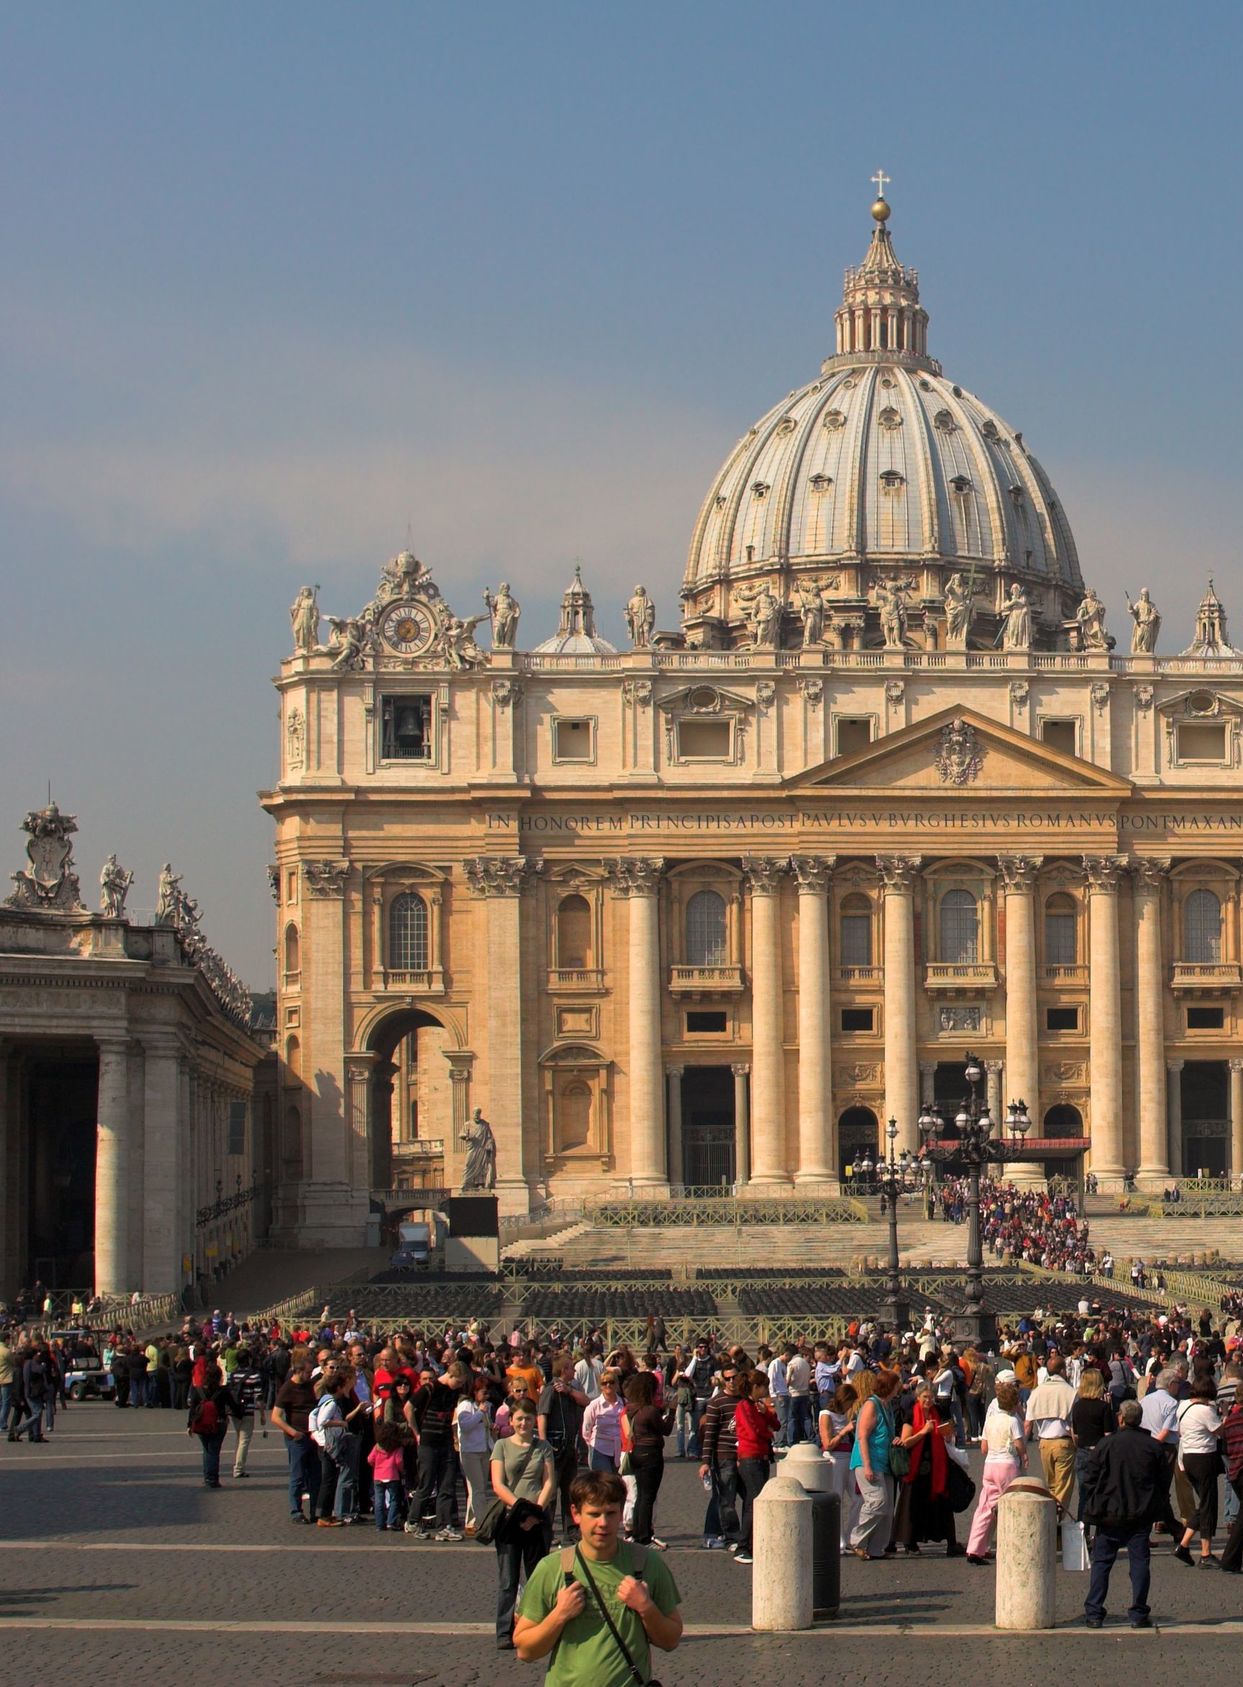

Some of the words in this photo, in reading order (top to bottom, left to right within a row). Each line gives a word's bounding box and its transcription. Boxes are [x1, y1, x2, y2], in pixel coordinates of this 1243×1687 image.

[487, 814, 511, 829] IN
[520, 815, 624, 831] HONOREM
[629, 813, 731, 830] PRINCIPIS
[735, 813, 797, 829] APOST
[801, 812, 867, 828] PAVLVS
[888, 813, 1011, 829] BVRGHESIVS
[1016, 813, 1117, 828] ROMANVS
[1120, 815, 1169, 830] PONT
[1172, 816, 1213, 830] MAX
[1216, 816, 1242, 830] AN
